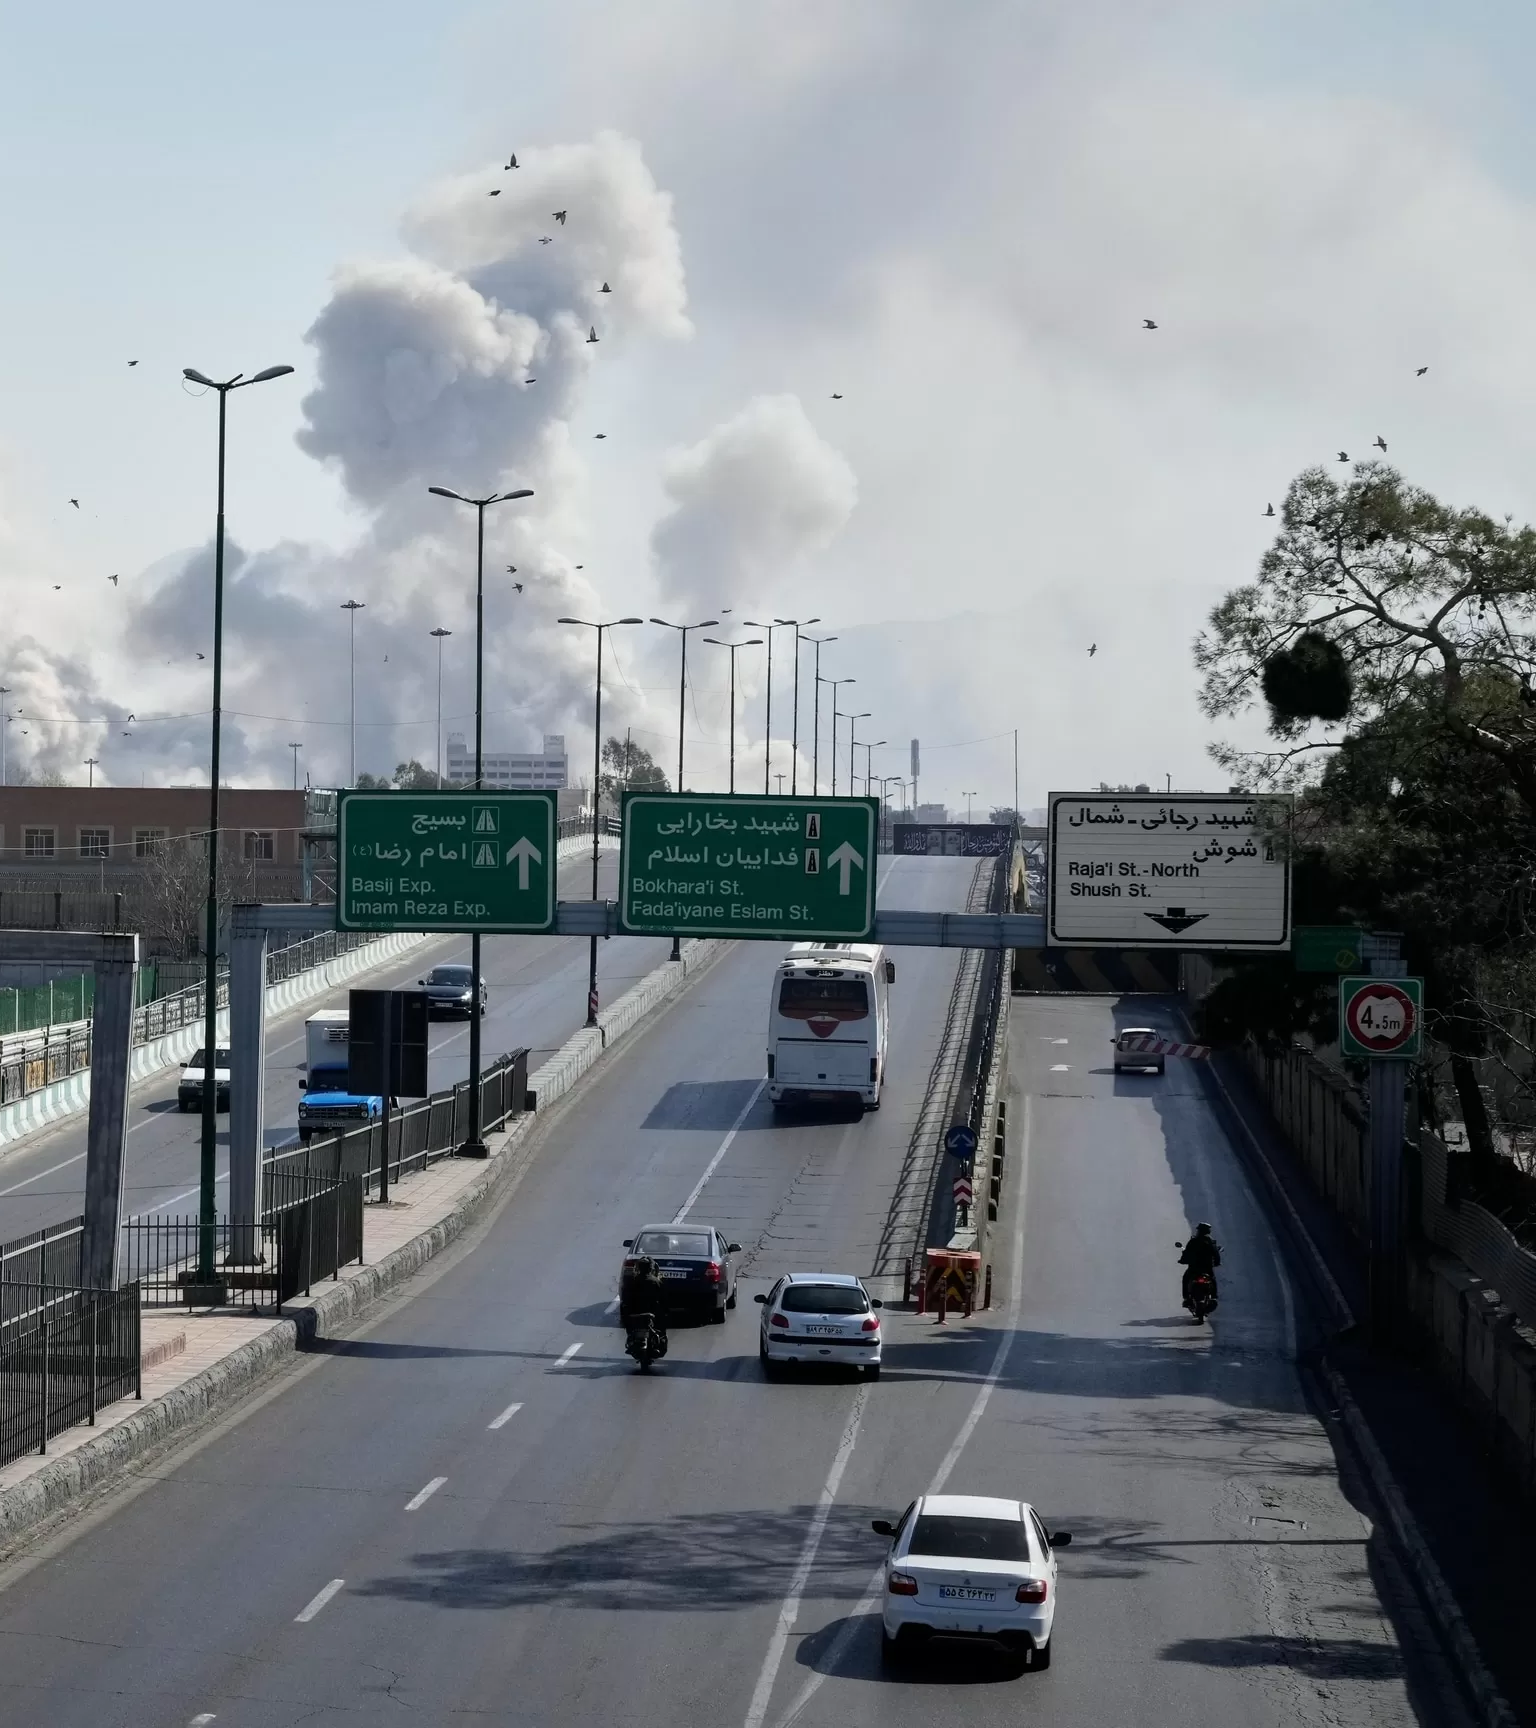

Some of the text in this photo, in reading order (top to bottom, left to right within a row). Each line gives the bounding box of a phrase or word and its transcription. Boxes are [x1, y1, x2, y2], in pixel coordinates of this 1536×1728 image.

[411, 814, 467, 835] بسیج
[656, 811, 800, 837] شهید بخارایی
[1068, 804, 1125, 828] شمال
[1204, 806, 1258, 830] شهید
[419, 843, 467, 868] امام
[647, 845, 799, 870] فداییان اسلام
[1192, 838, 1258, 864] شوش
[1068, 861, 1113, 879] Raja'i
[352, 877, 436, 896] Basij Exp.
[633, 877, 744, 896] Bokhara'i St.
[1070, 882, 1152, 898] Shush St.
[351, 899, 491, 918] Imam Reza Exp.
[632, 900, 814, 921] Fada'iyane Eslam St.
[1360, 1005, 1401, 1030] 4.5m
